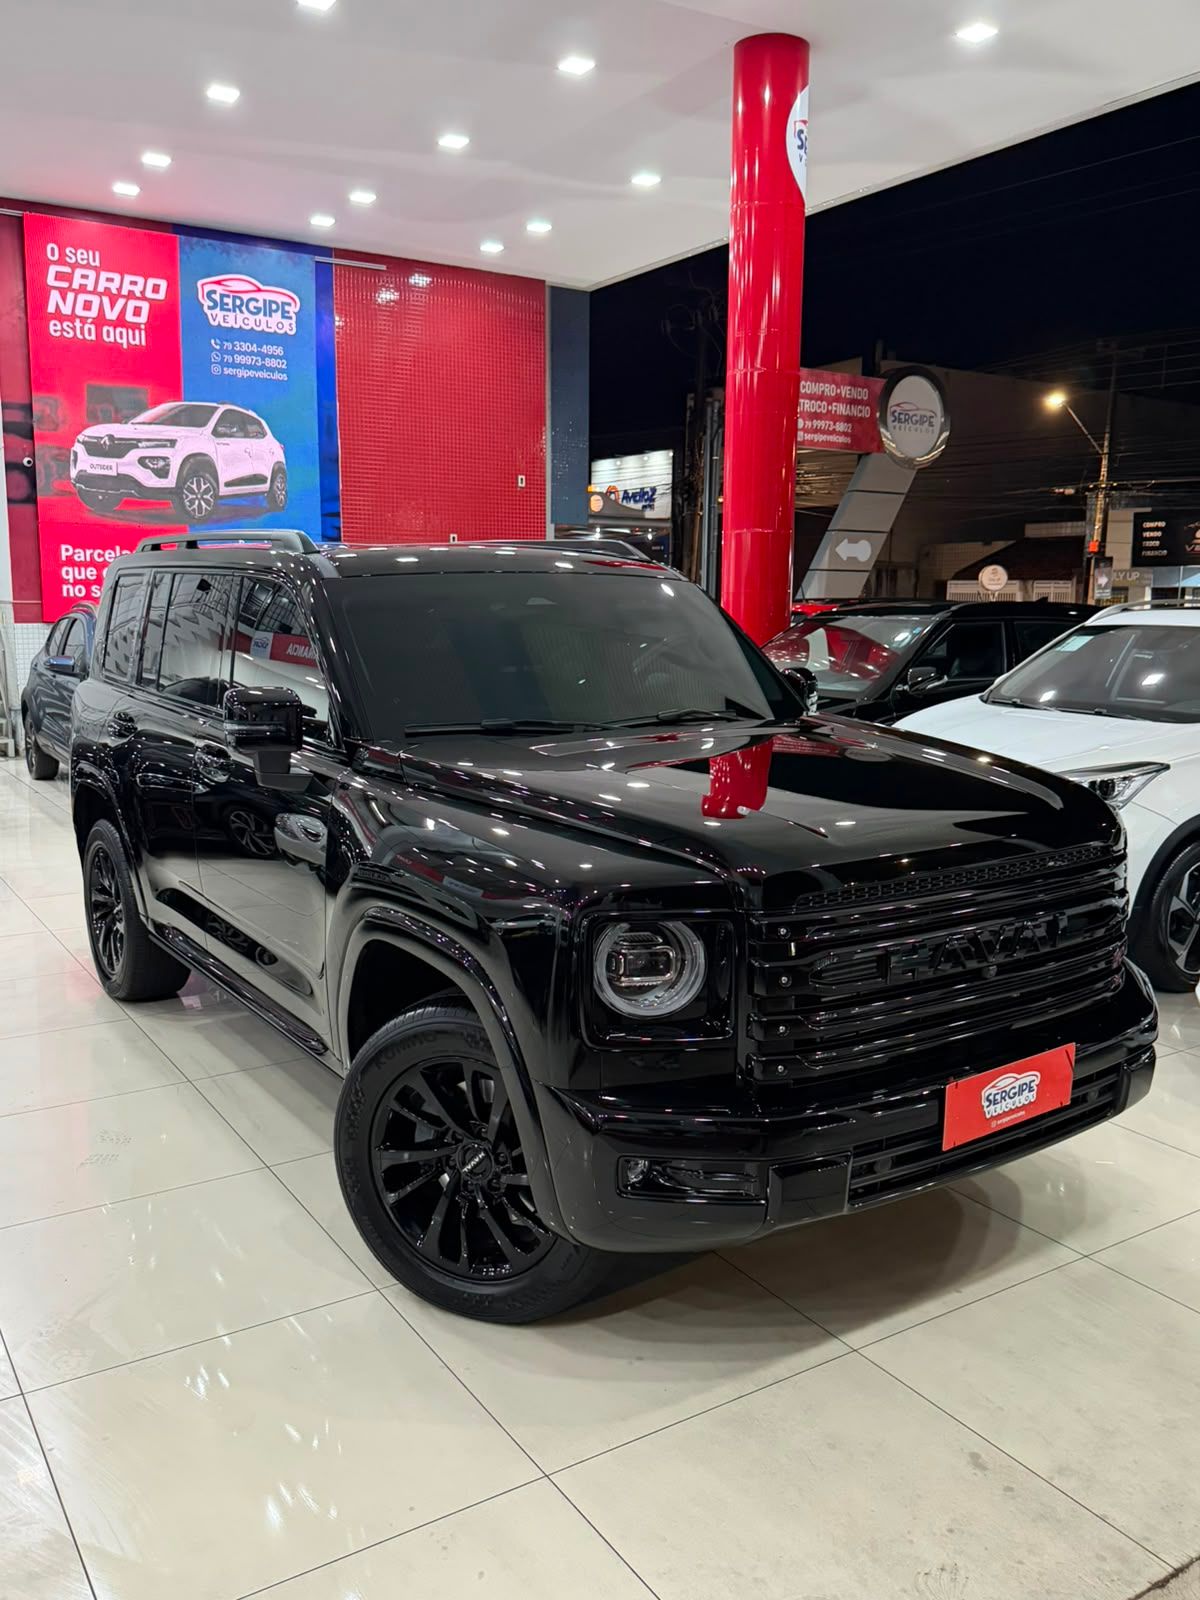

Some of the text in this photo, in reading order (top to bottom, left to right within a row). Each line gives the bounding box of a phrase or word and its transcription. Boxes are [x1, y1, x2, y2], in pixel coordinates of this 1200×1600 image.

[66, 246, 100, 267] seu
[47, 265, 168, 301] CARRO
[47, 289, 150, 324] NOVO
[206, 289, 293, 320] SERGIPE
[211, 313, 293, 331] VEÍCULOS
[49, 318, 146, 349] está aqui
[234, 341, 284, 356] 3304-4956
[234, 354, 287, 369] 99973-8802
[223, 366, 288, 381] sergipeveiculos
[891, 410, 935, 428] SERGIPE
[62, 566, 98, 583] que
[63, 584, 87, 598] no
[985, 1079, 1036, 1109] SERGIPE
